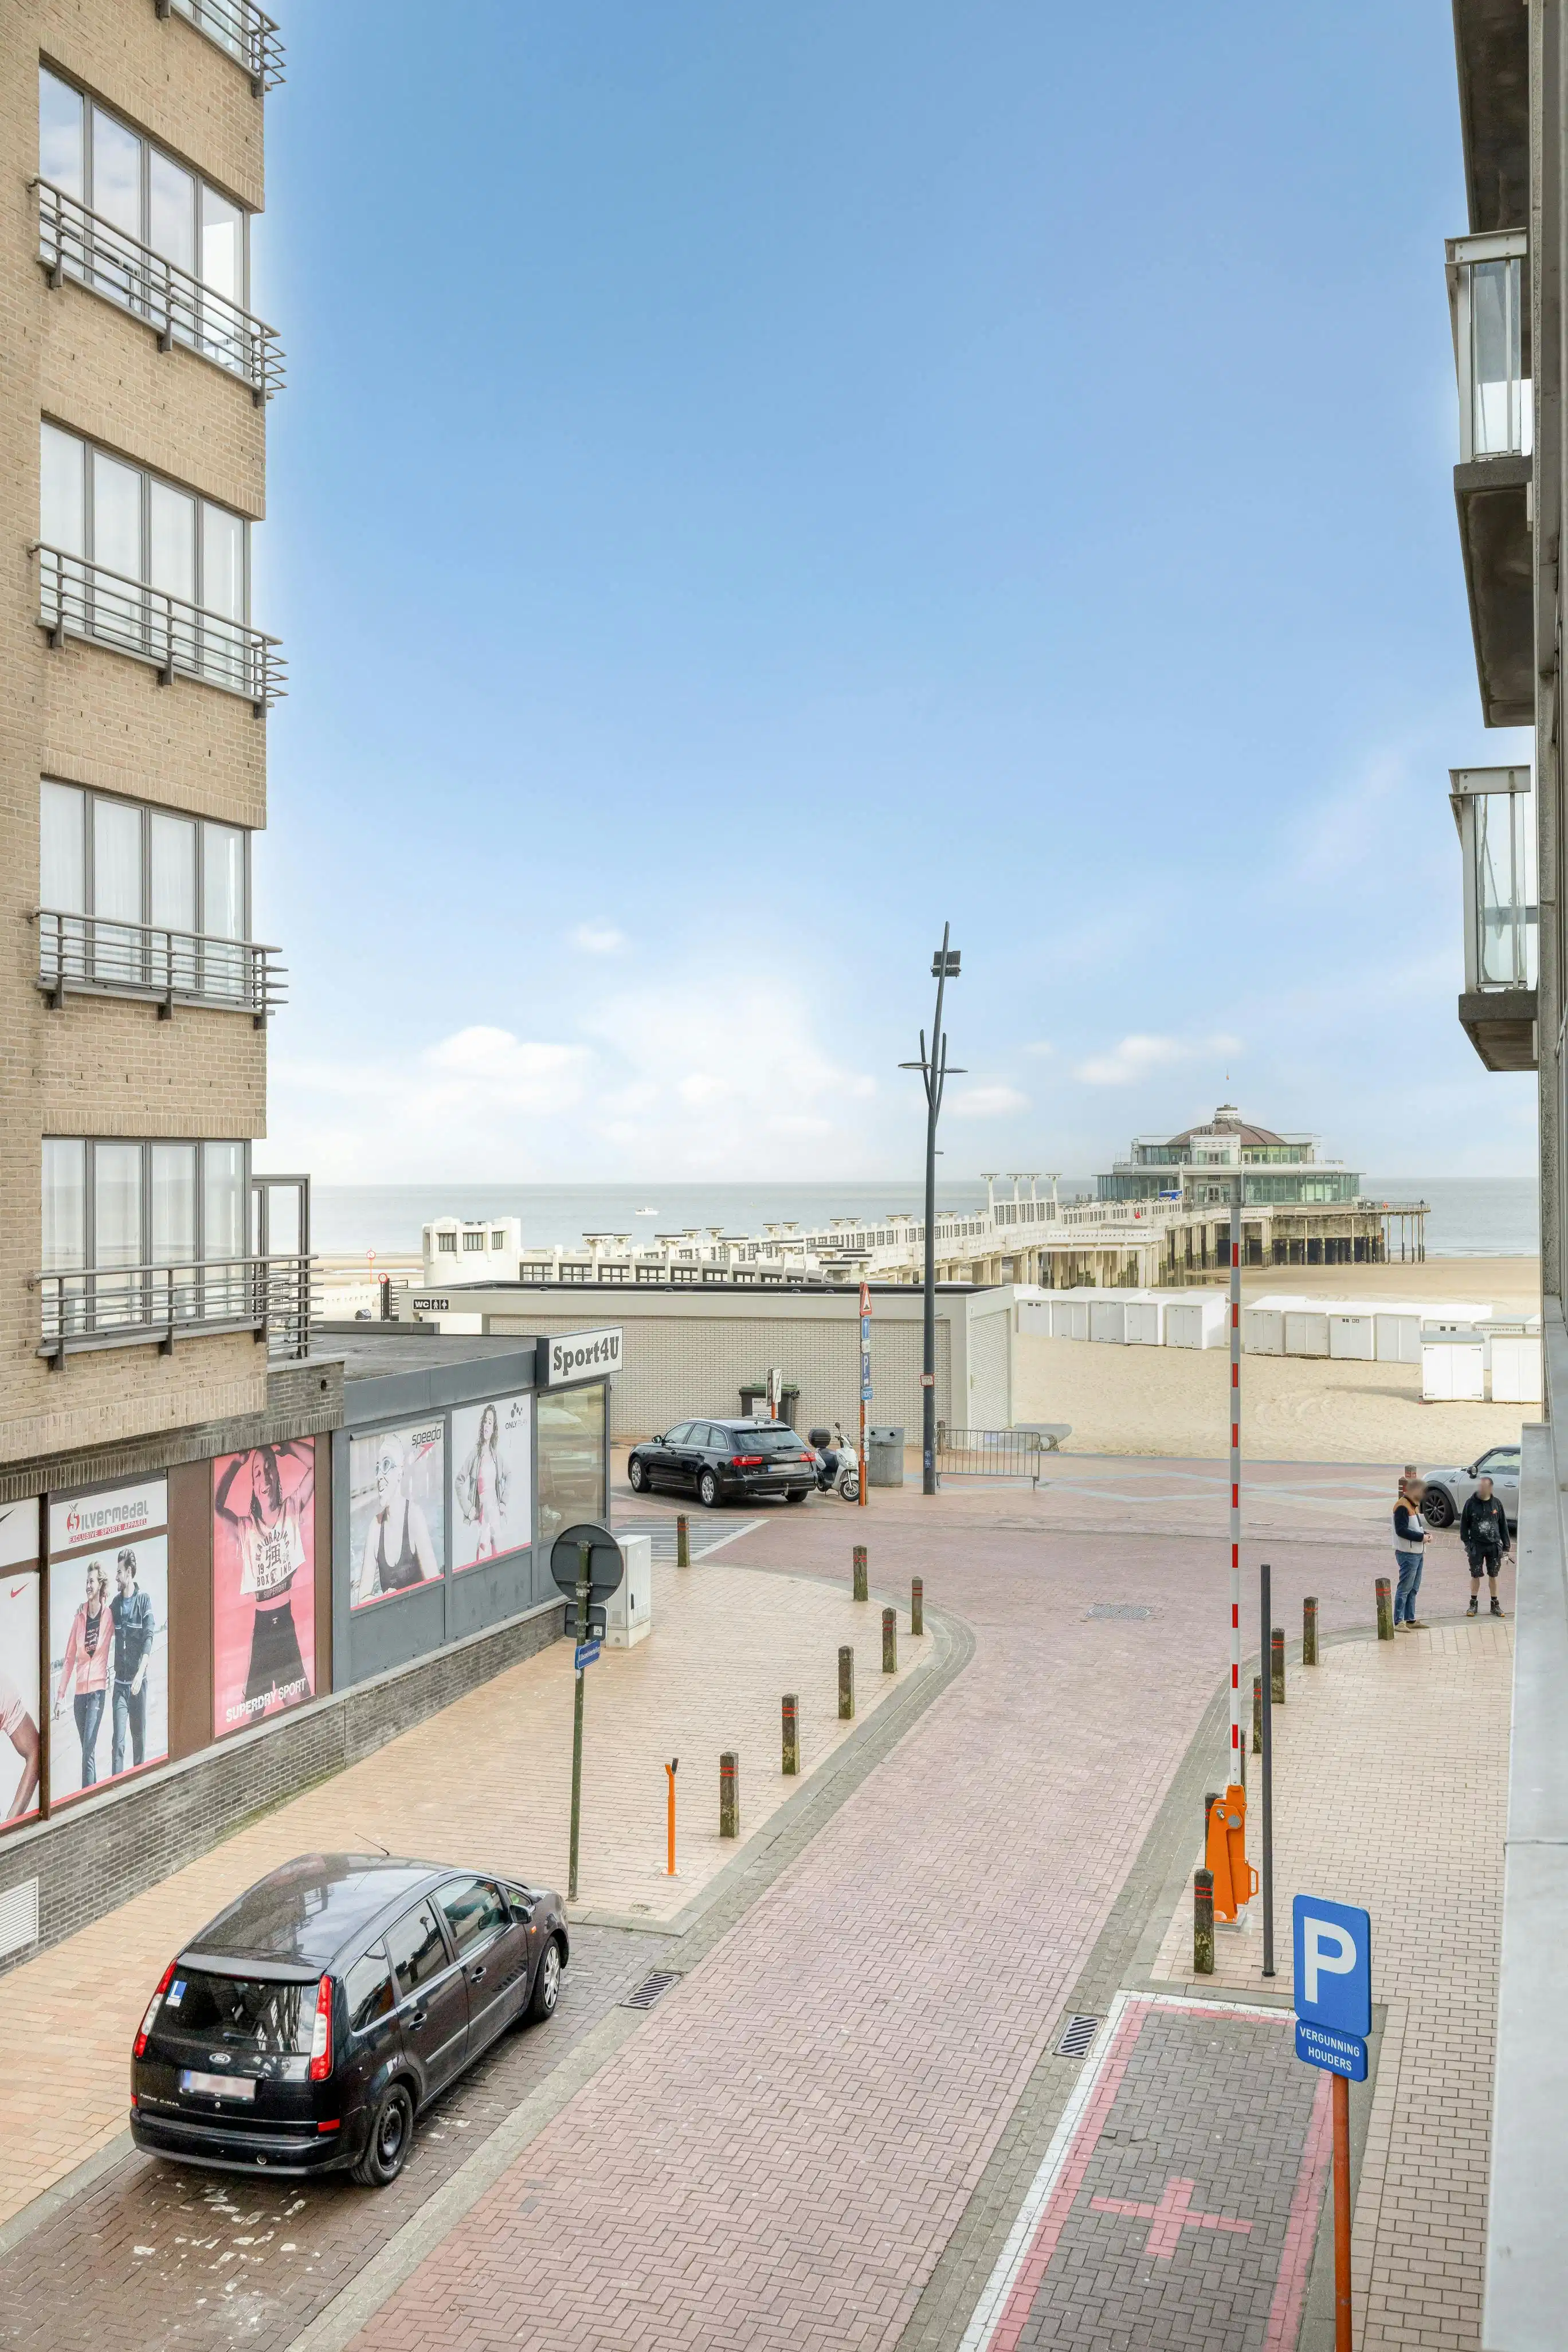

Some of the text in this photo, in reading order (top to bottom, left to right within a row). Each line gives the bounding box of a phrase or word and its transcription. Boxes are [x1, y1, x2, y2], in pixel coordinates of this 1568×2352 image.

[554, 1336, 619, 1376] Sport4U
[864, 1355, 868, 1374] P
[505, 1421, 518, 1429] ONLY
[412, 1426, 441, 1448] speedo
[69, 1519, 147, 1543] EXCLUSIVE SPORTS APPAREL
[258, 1563, 264, 1575] 19
[264, 1582, 287, 1598] SUPERDRY
[226, 1677, 306, 1723] SUPERDRY SPORT
[1304, 1916, 1357, 2004] P
[1299, 2026, 1360, 2057] VERGUNNING
[1308, 2045, 1353, 2072] HOUDERS
[140, 2093, 158, 2102] FOCUS
